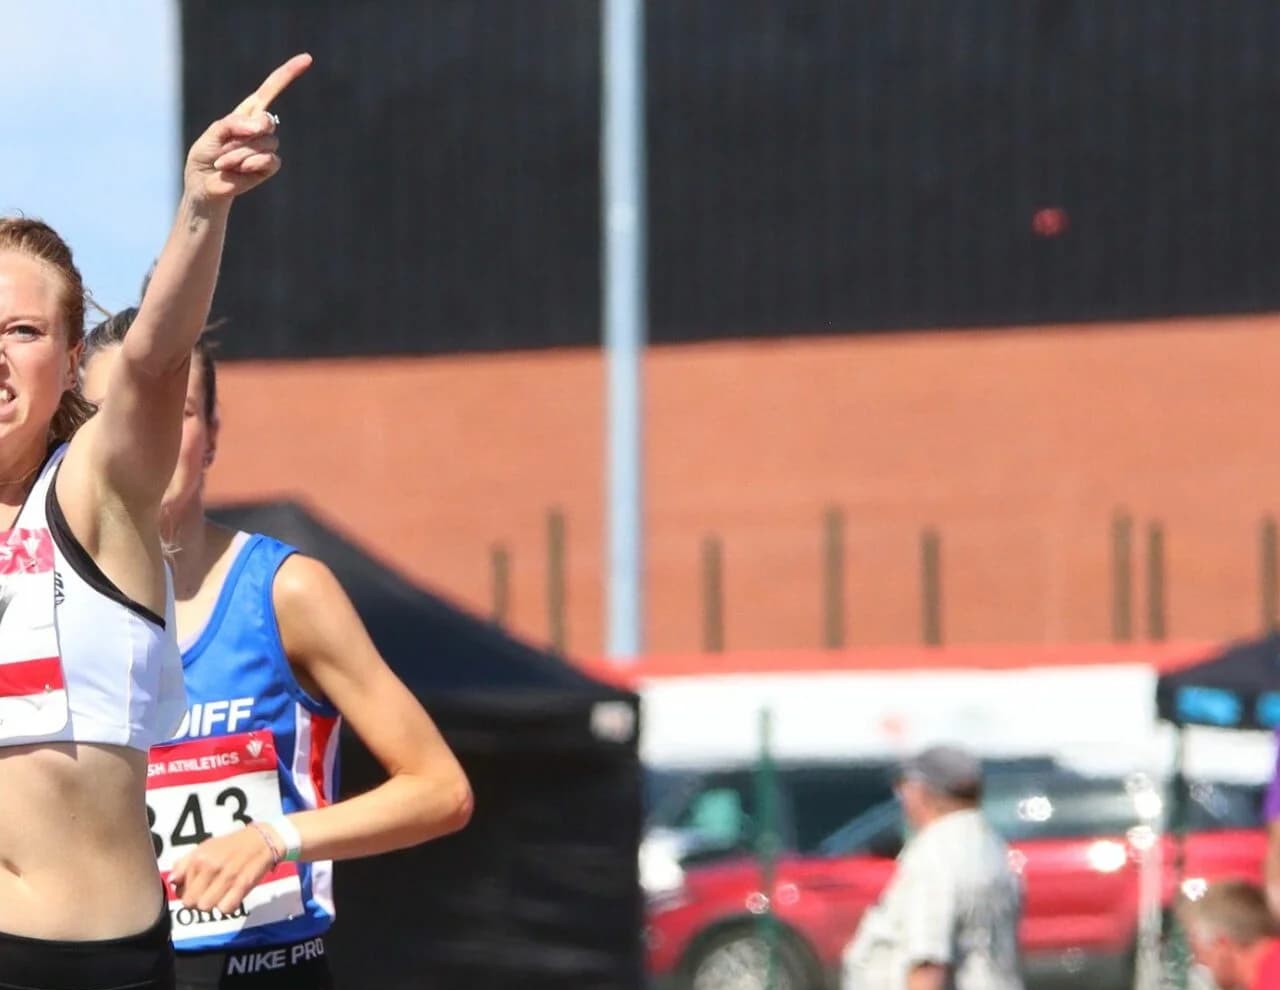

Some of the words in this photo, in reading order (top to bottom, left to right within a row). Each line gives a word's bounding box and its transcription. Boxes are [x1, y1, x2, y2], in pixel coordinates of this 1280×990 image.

[168, 752, 241, 774] ATHLETICS
[227, 949, 288, 976] NIKE
[291, 937, 325, 965] PRO
